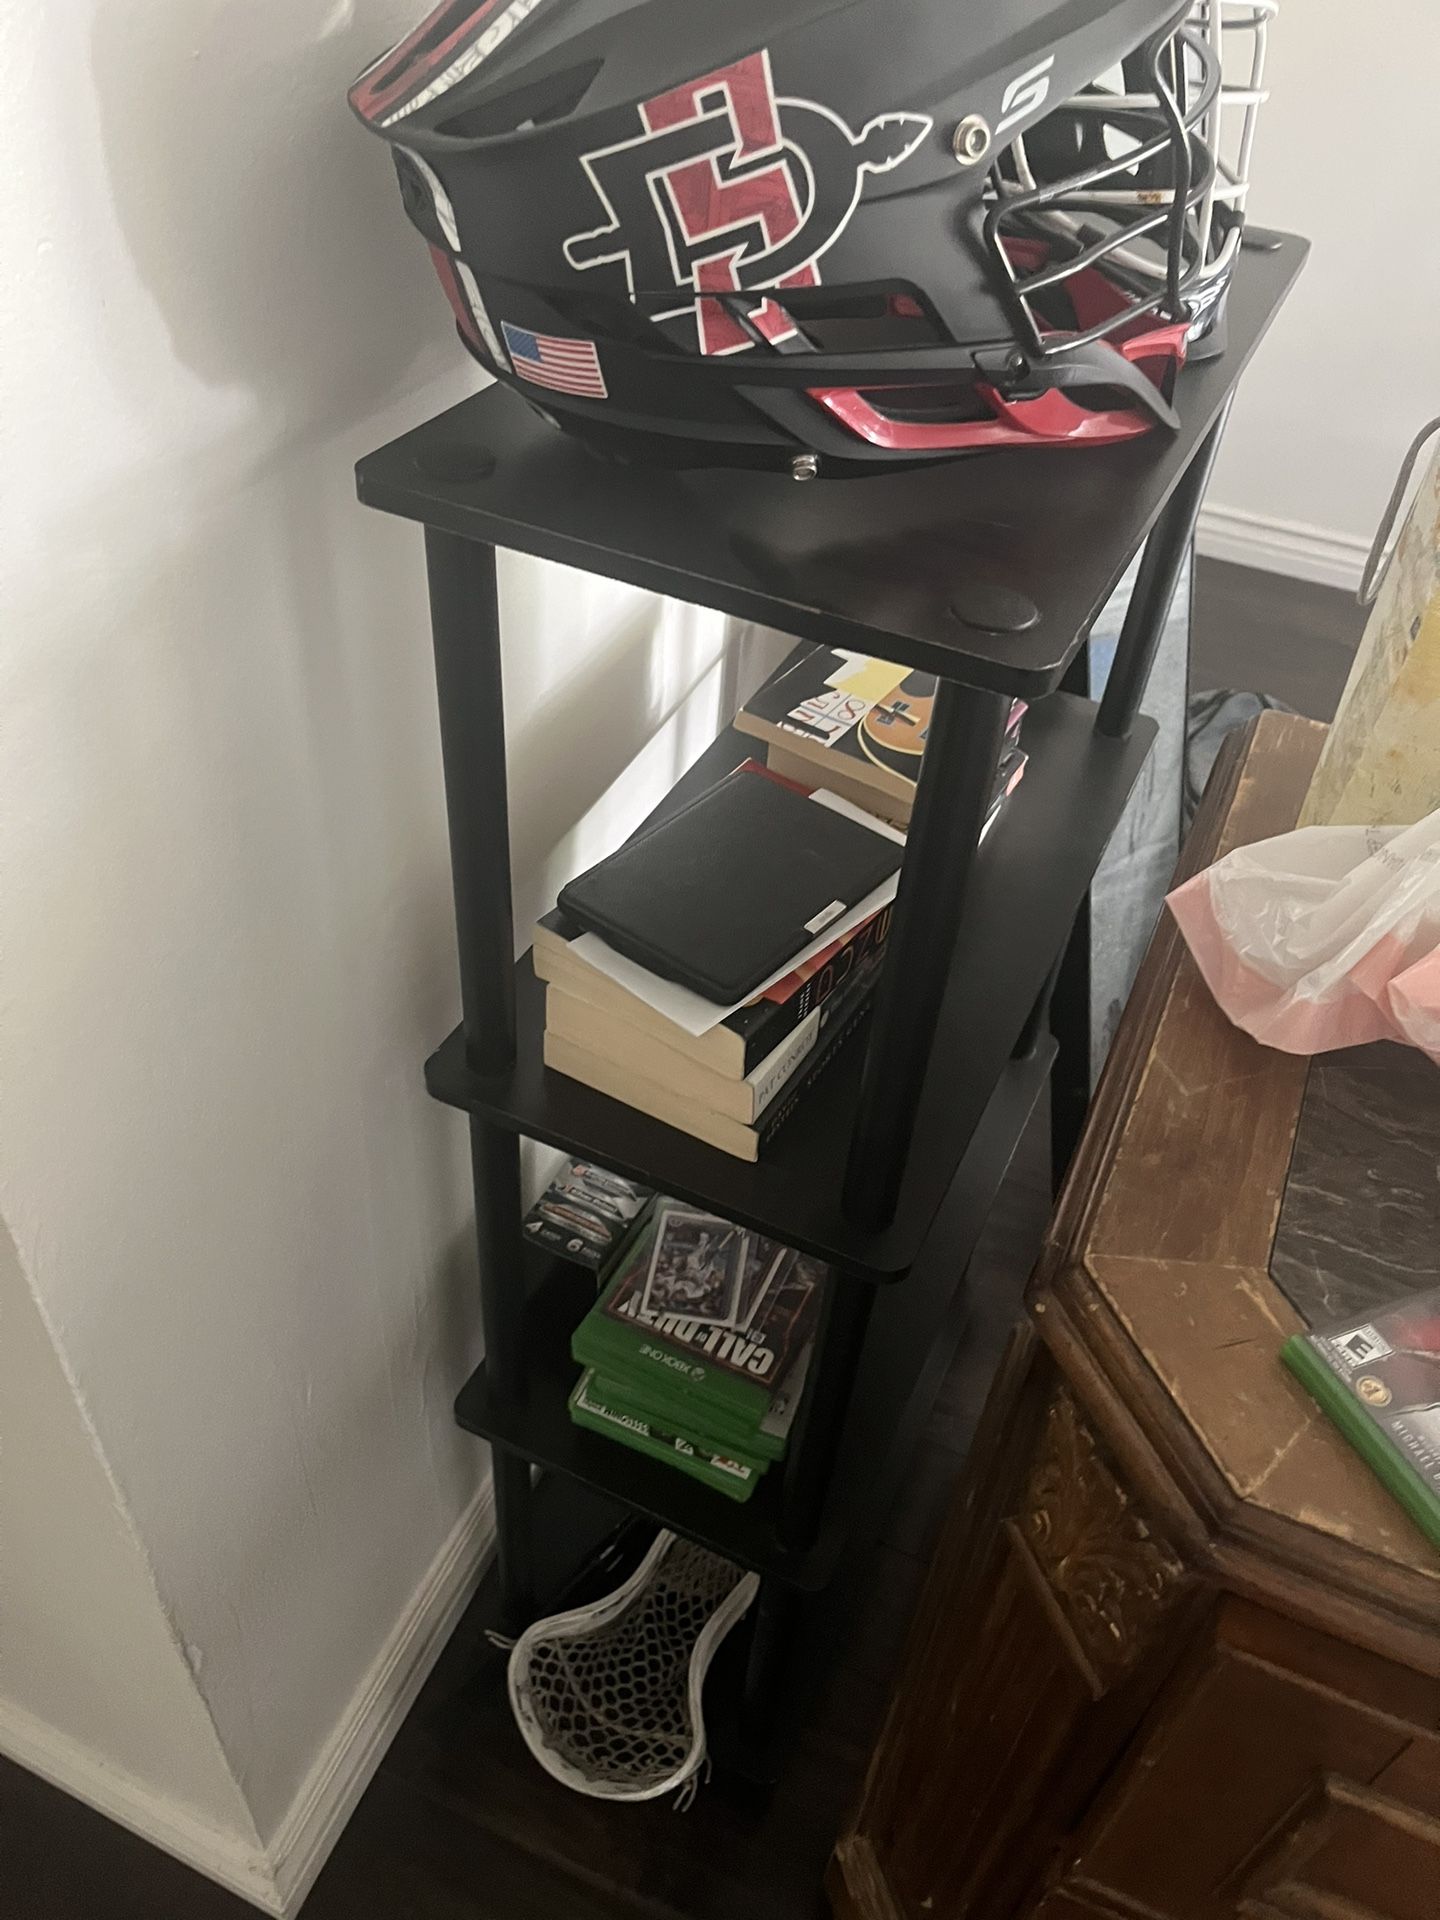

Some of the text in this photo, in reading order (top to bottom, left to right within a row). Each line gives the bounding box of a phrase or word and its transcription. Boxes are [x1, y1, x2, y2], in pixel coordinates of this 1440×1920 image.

[702, 1325, 776, 1375] CALL
[1346, 1334, 1374, 1360] E
[1391, 1420, 1435, 1469] MICHAEL
